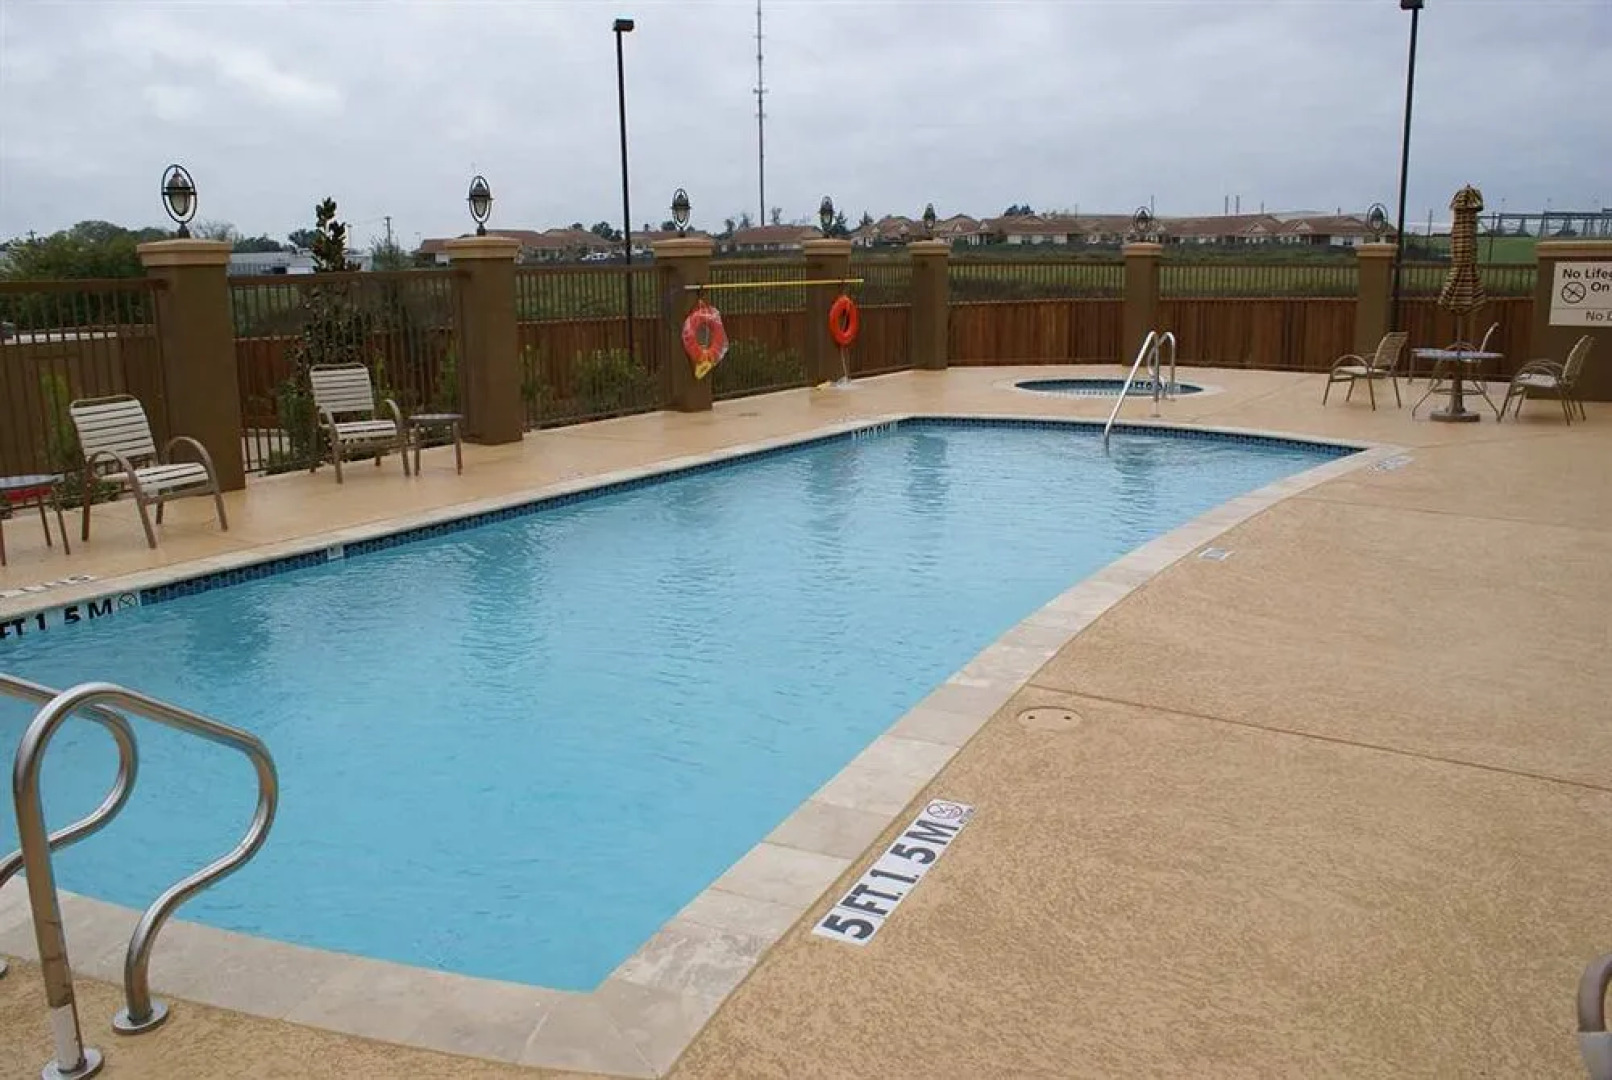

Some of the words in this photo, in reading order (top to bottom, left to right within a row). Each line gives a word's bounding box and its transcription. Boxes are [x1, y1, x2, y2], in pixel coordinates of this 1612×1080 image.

[1563, 269, 1580, 278] No
[1591, 282, 1609, 292] On
[1586, 311, 1602, 321] No
[87, 598, 112, 619] M
